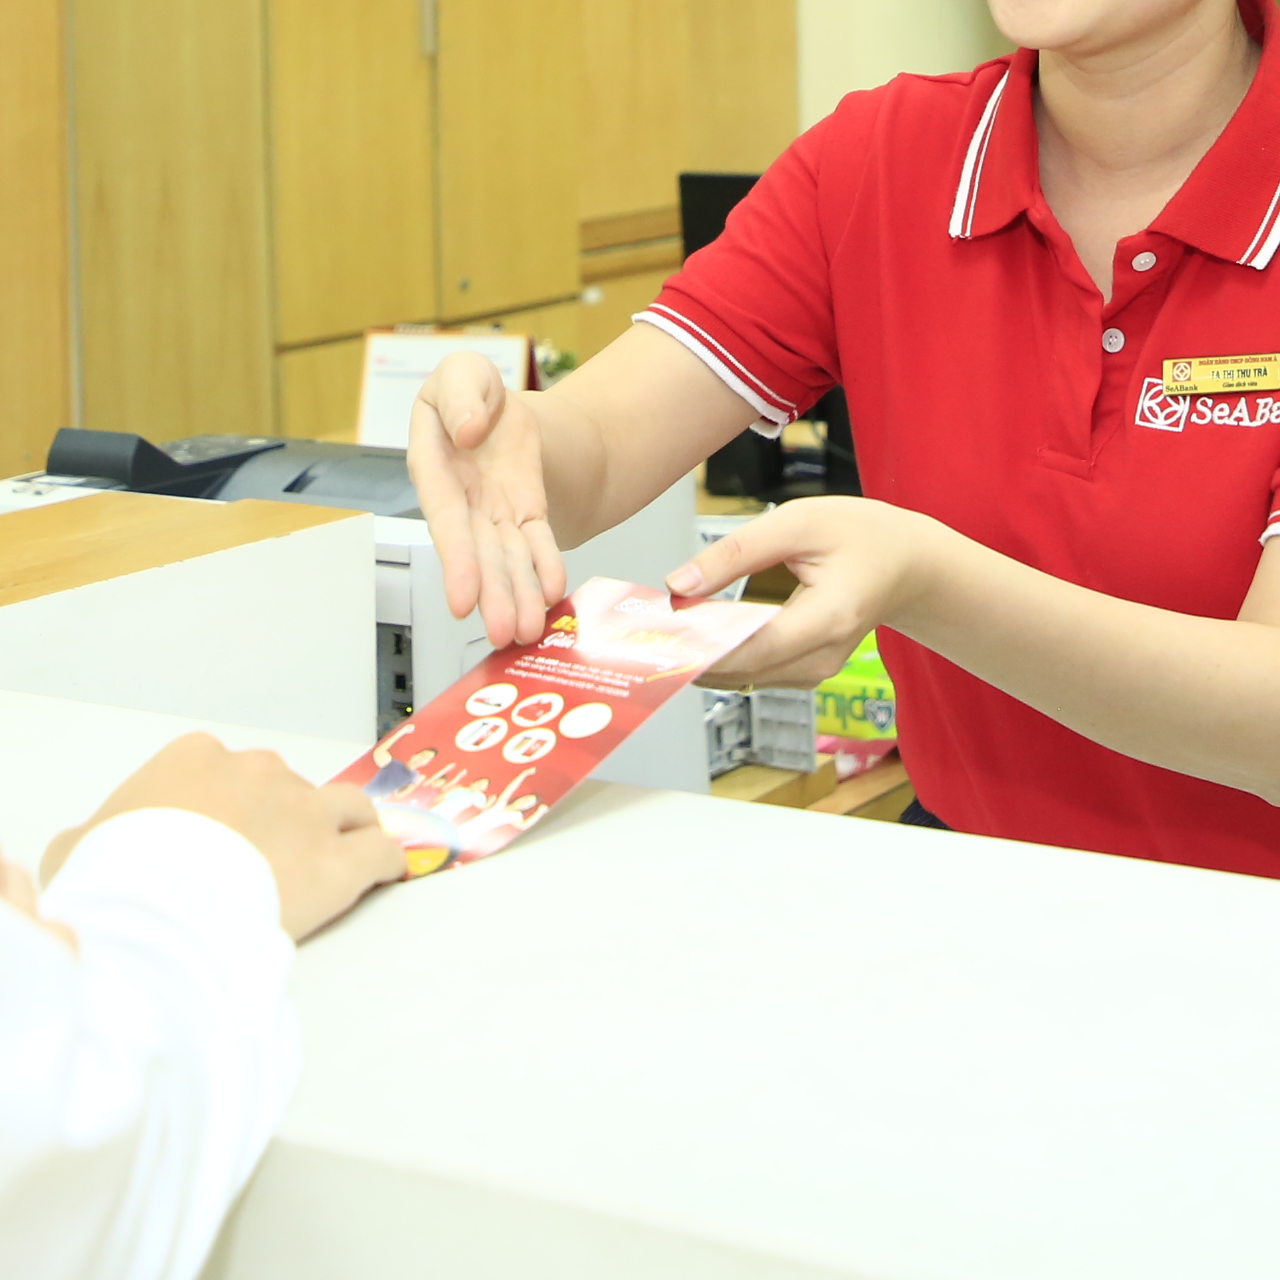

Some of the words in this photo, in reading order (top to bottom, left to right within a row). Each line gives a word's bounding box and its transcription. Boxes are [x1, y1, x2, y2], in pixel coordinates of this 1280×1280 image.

[1237, 368, 1251, 378] THU
[1253, 366, 1268, 377] TRÀ
[1165, 384, 1199, 393] SeABank
